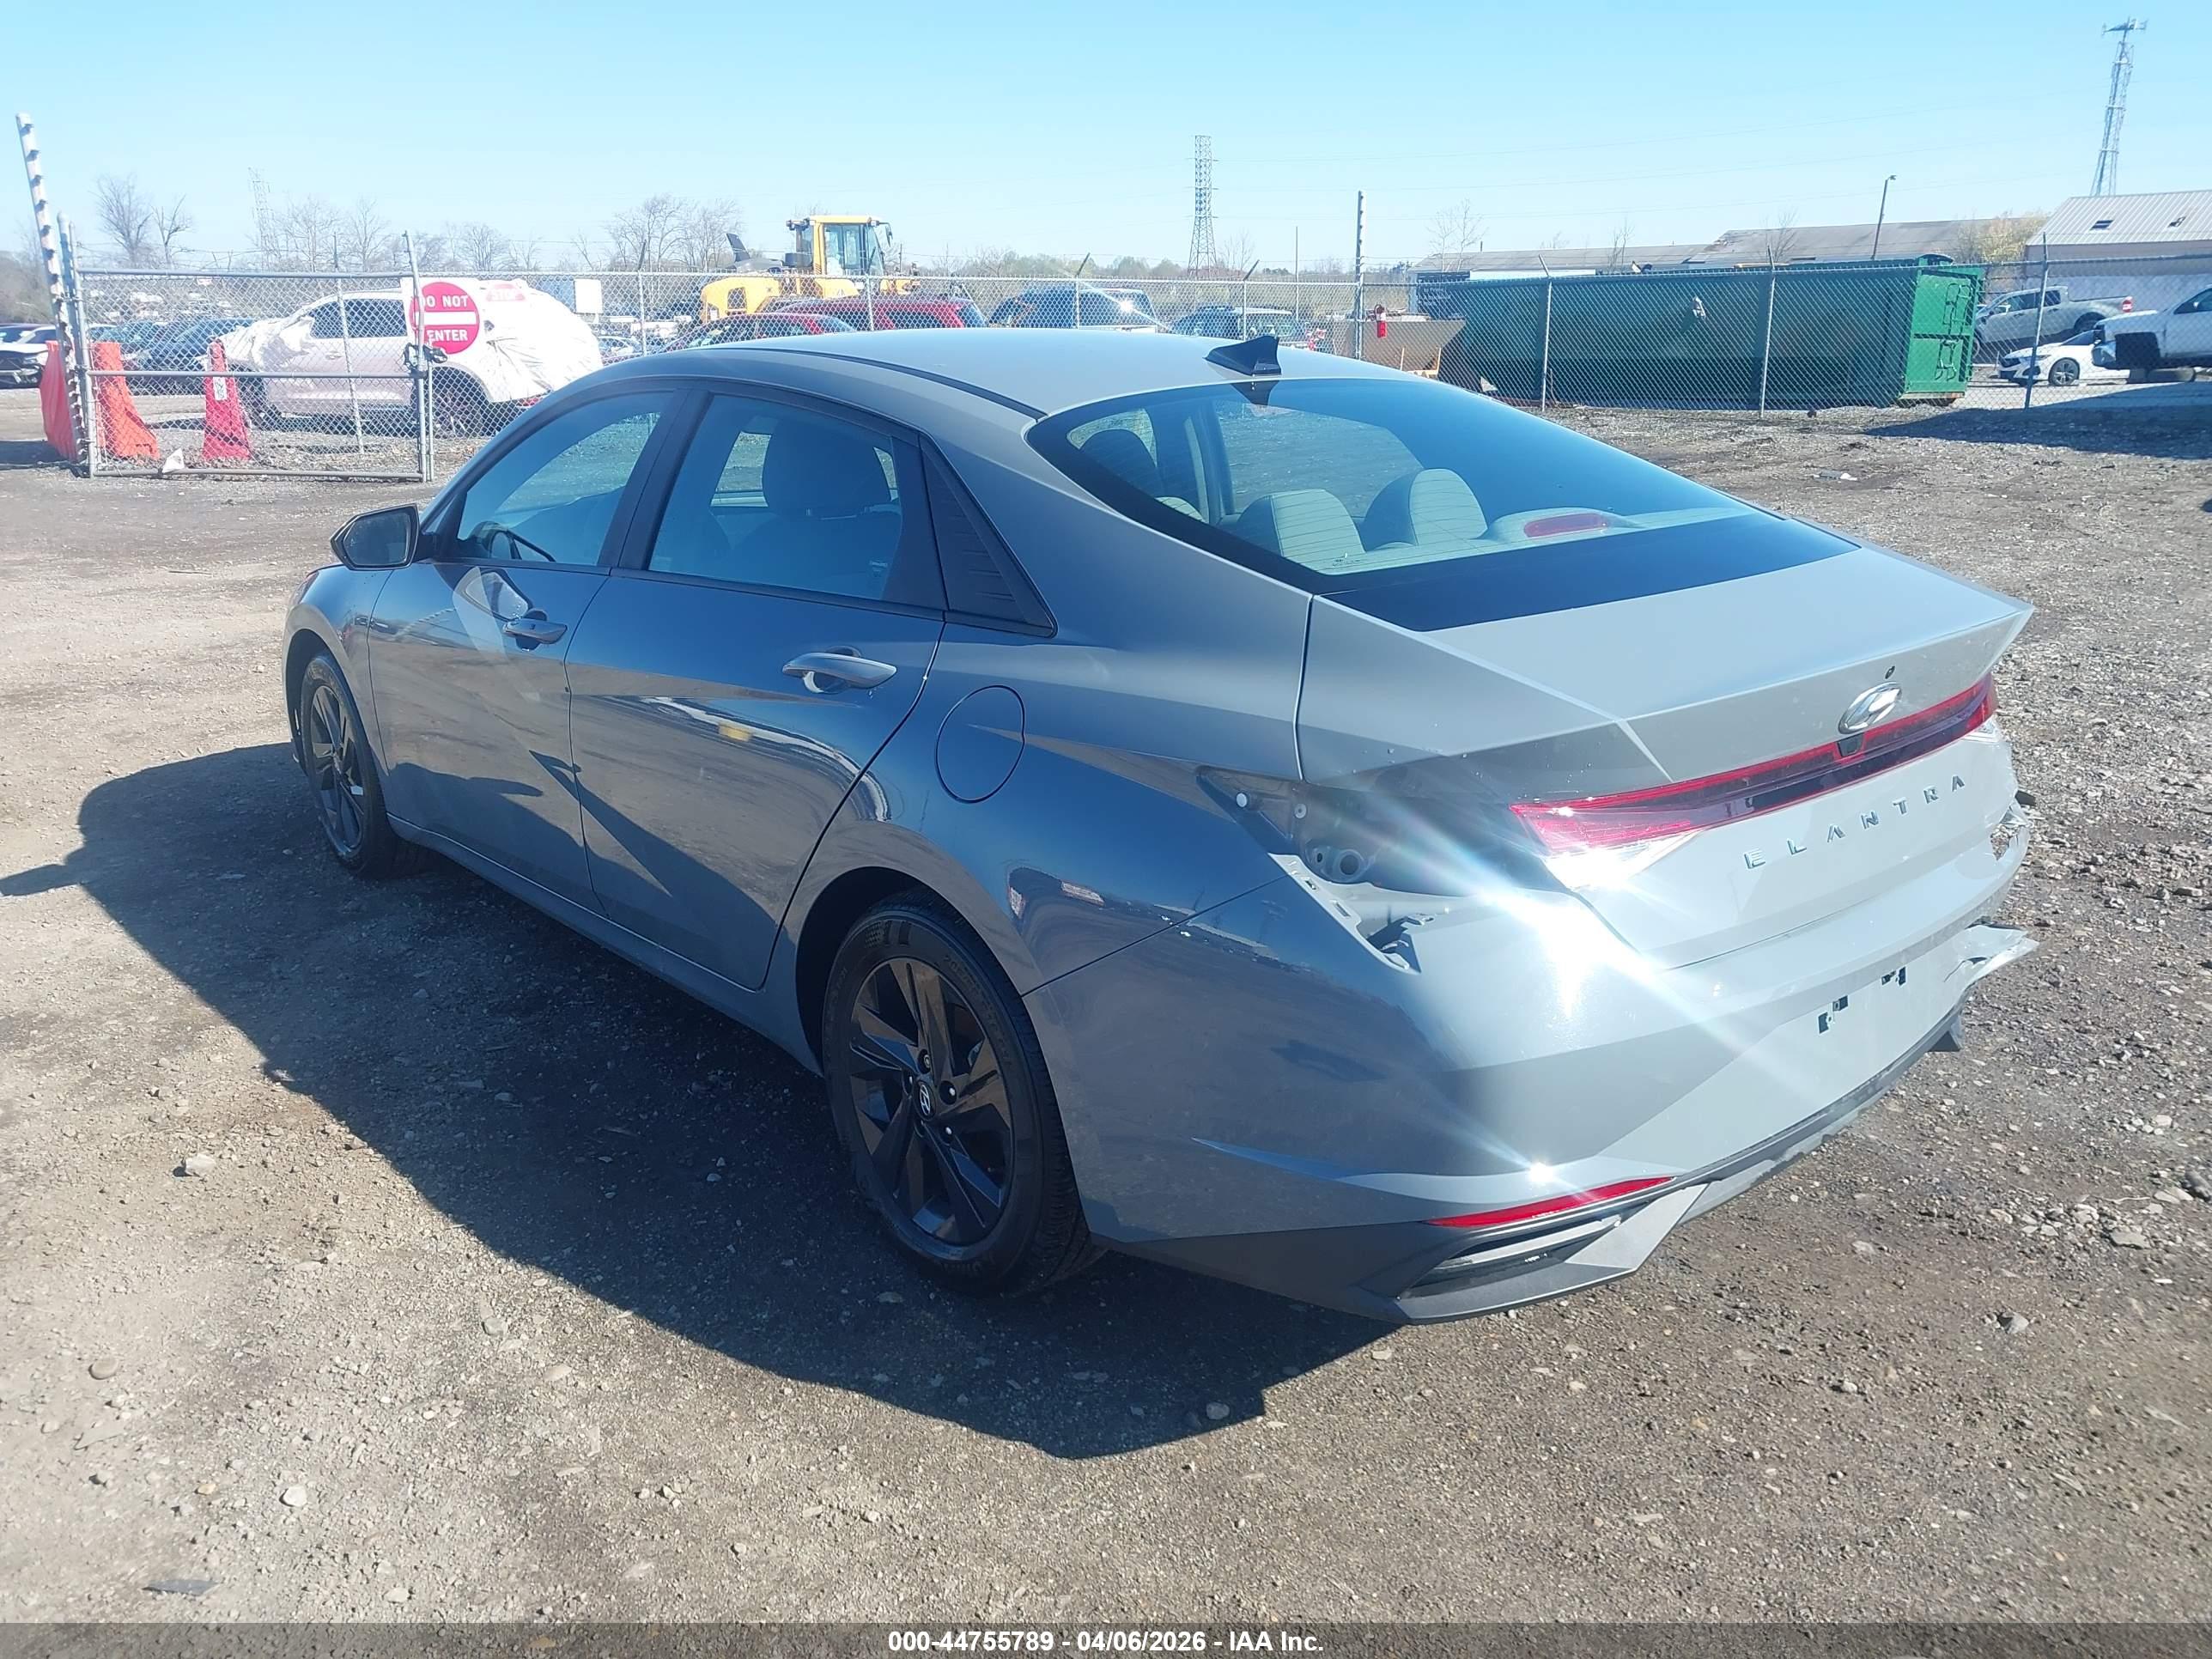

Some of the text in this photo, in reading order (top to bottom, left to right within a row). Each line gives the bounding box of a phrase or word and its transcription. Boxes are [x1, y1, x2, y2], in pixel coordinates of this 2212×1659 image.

[442, 295, 468, 307] NOT
[426, 330, 468, 341] ENTER
[1744, 775, 1966, 869] ELANTRA
